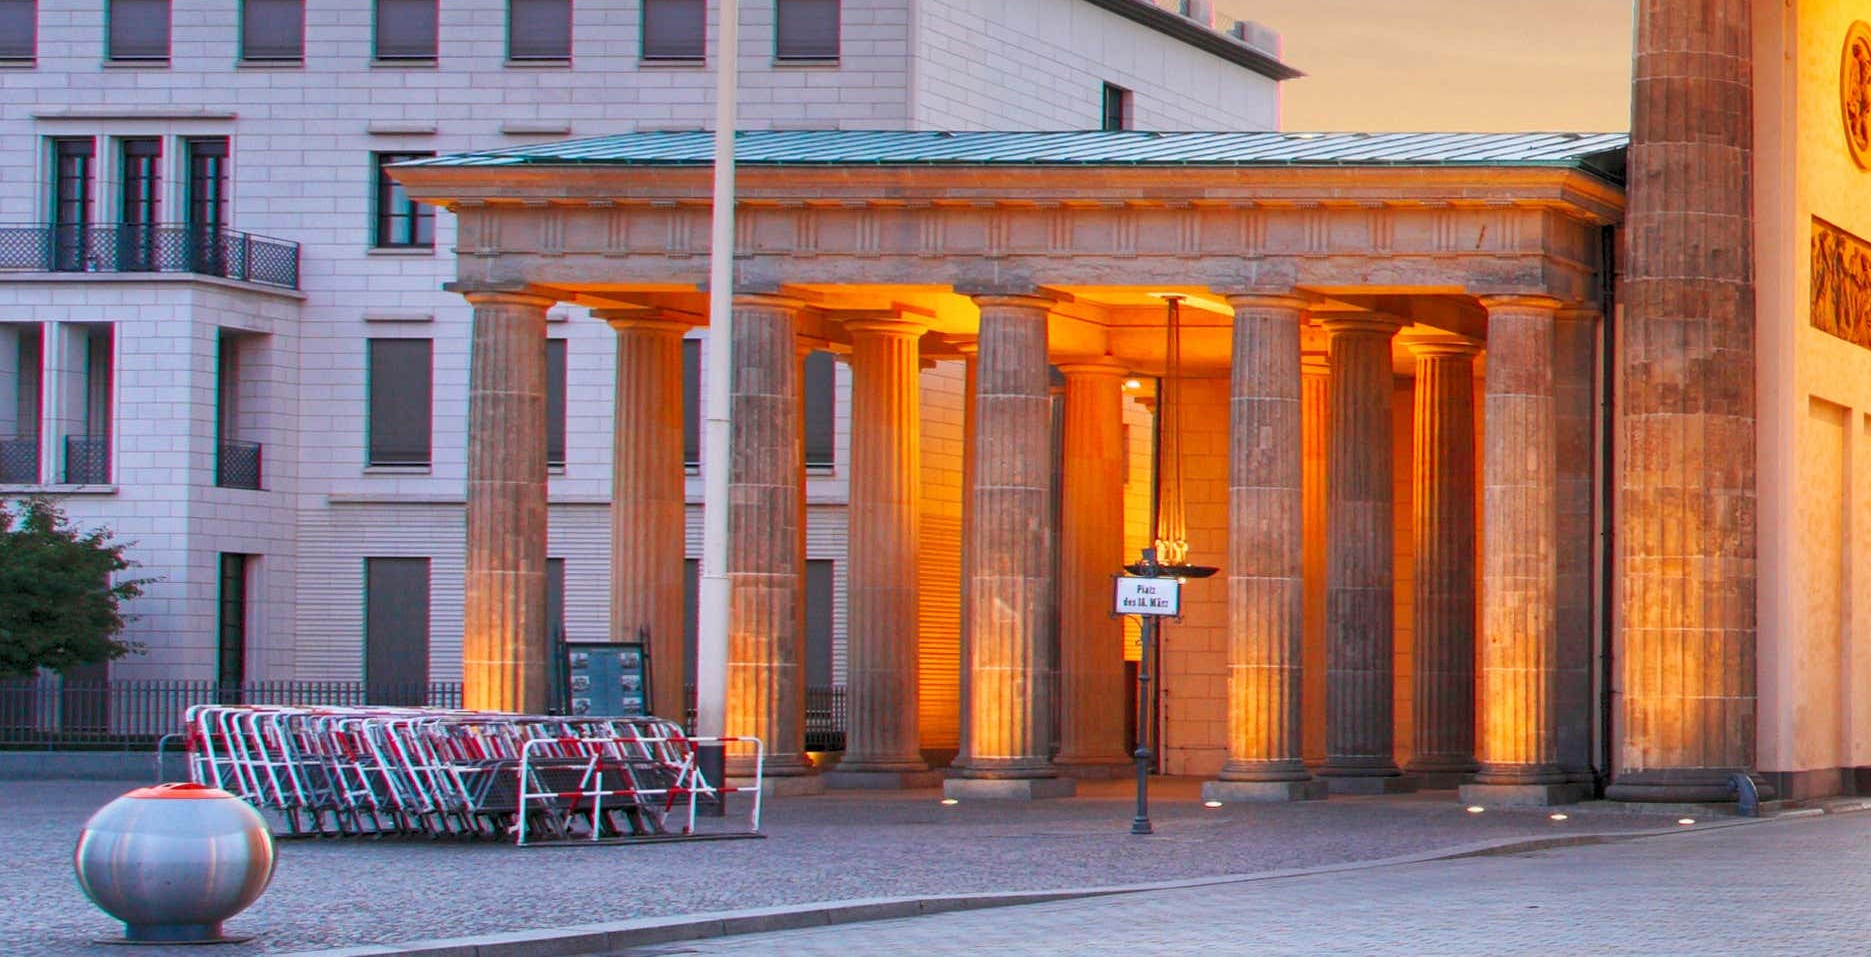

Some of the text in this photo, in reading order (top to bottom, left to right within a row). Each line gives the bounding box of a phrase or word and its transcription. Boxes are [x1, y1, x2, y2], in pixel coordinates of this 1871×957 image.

[1137, 584, 1156, 594] Platz
[1123, 596, 1169, 607] des 18. März
